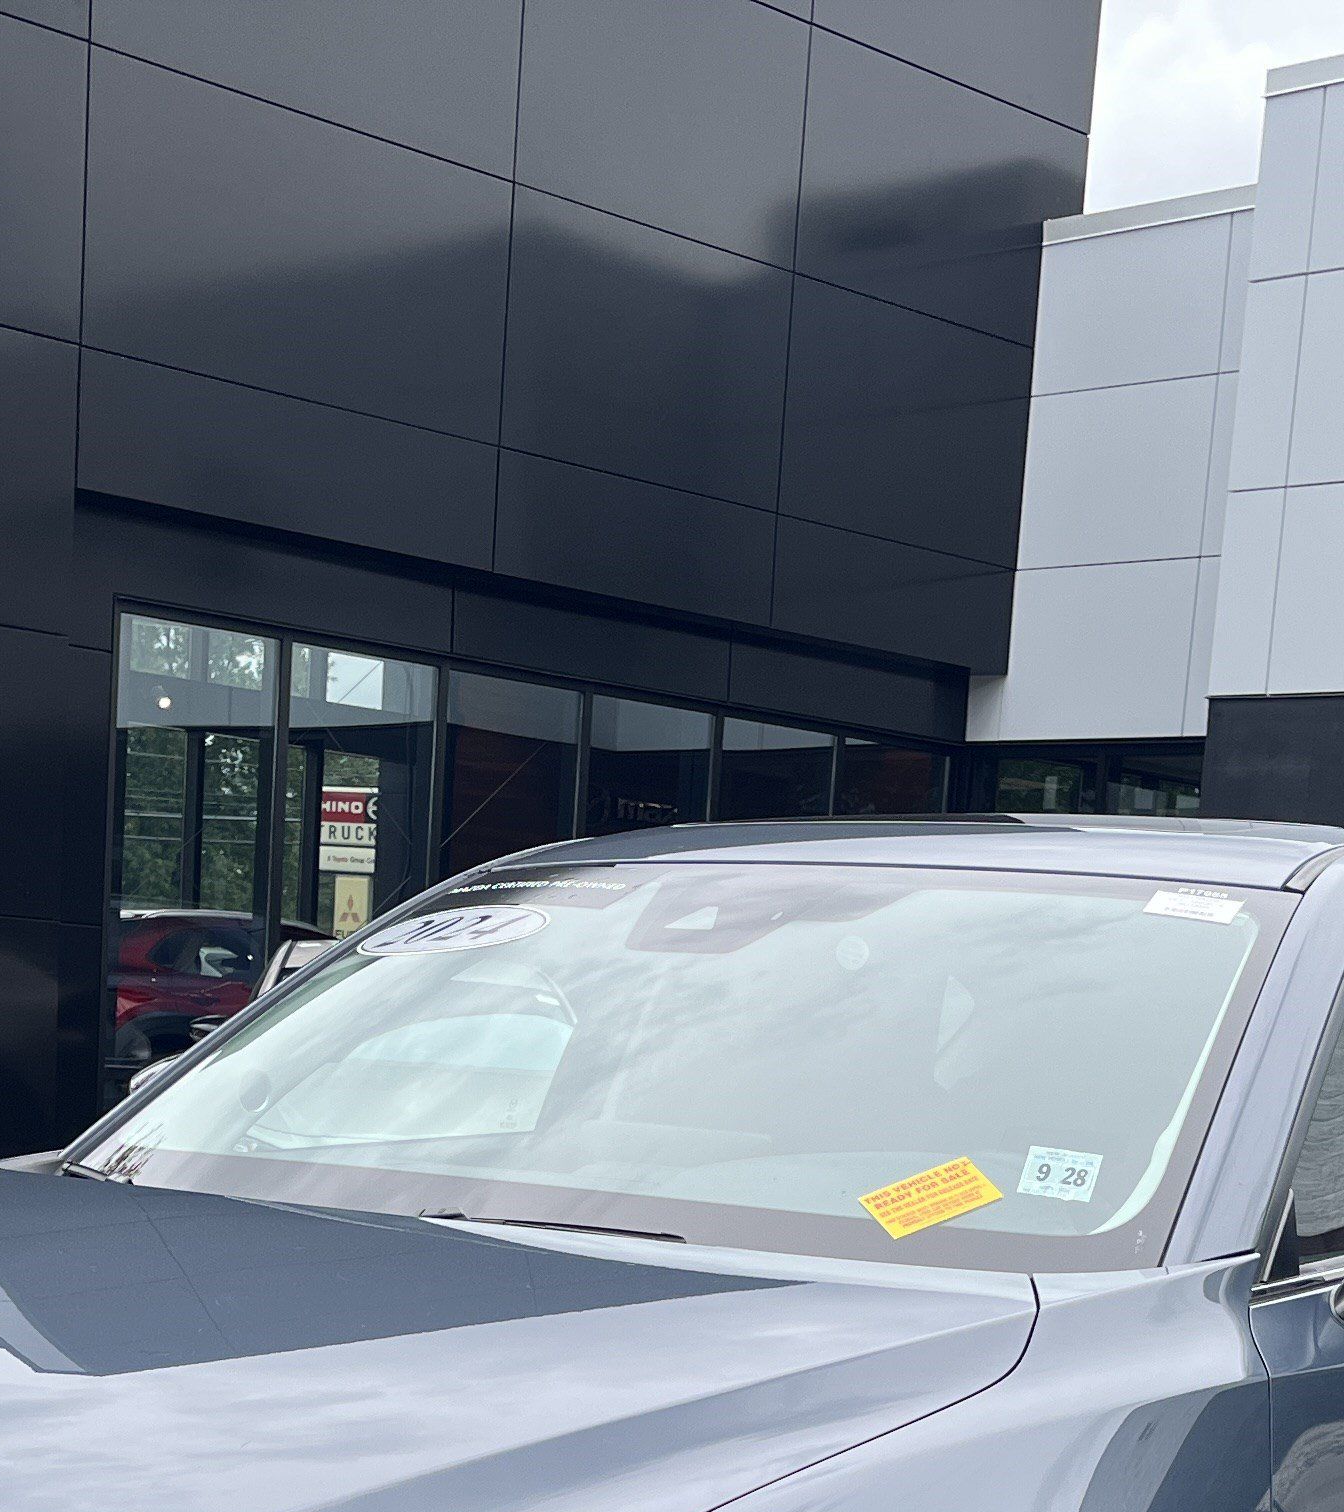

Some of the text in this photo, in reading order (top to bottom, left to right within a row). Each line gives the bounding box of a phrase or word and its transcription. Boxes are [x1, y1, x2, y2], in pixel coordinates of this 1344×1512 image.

[864, 1190, 891, 1204] THIS
[892, 1170, 941, 1193] VEHICLE
[873, 1168, 970, 1210] READY FOR SALE
[1036, 1163, 1089, 1188] 9 28
